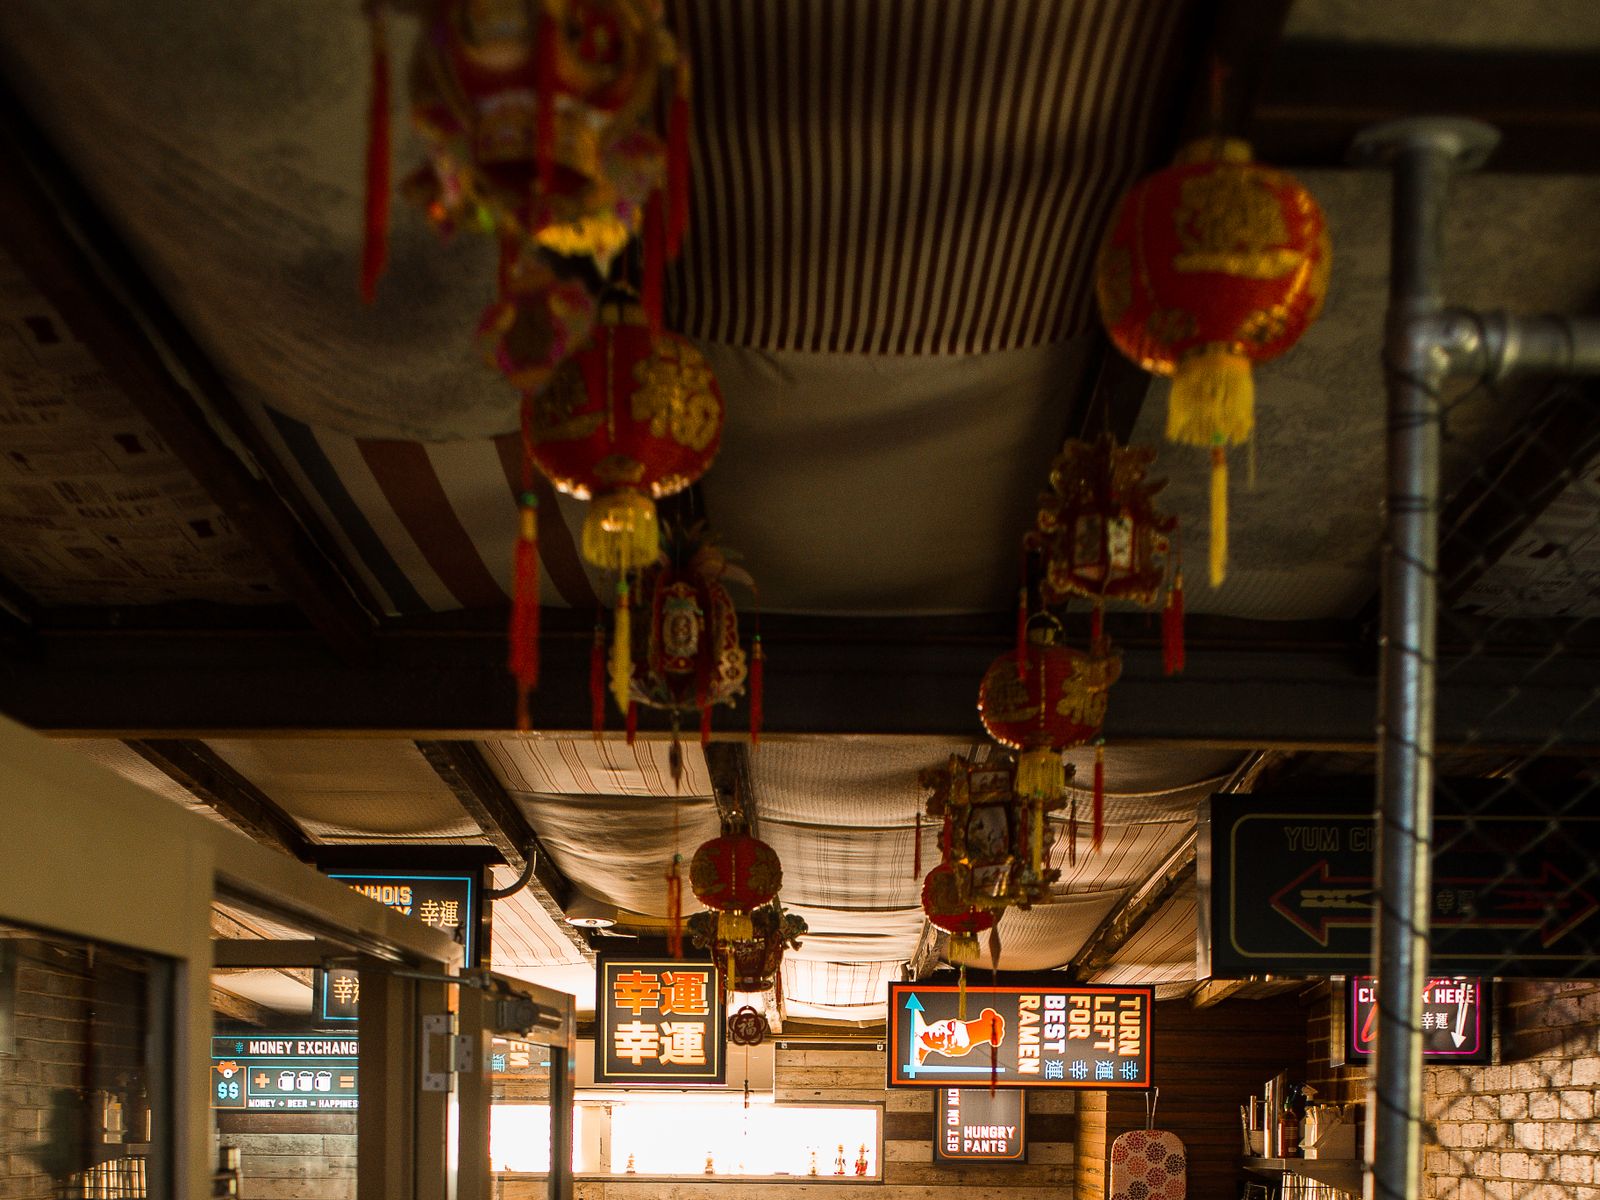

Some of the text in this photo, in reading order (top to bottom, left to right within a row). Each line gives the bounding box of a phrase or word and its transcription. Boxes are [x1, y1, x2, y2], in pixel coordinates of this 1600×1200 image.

[1283, 827, 1339, 851] YUM
[420, 900, 459, 928] 幸運
[614, 970, 710, 1016] 幸運
[1435, 989, 1474, 1004] HERE
[1043, 995, 1066, 1054] BEST
[1068, 996, 1091, 1040] FOR
[1094, 996, 1116, 1054] LEFT
[1118, 997, 1141, 1057] TURN
[1421, 1012, 1449, 1030] 幸運
[614, 1020, 708, 1066] 幸運
[1018, 995, 1041, 1075] RAMEN
[249, 1041, 293, 1055] MONEY
[298, 1041, 359, 1055] EXCHANG
[248, 1098, 276, 1108] MONEY
[287, 1098, 308, 1108] BEER
[318, 1098, 359, 1108] HAPPINES
[947, 1109, 960, 1126] ON
[947, 1129, 960, 1152] GET
[963, 1125, 1017, 1140] HUNGRY
[963, 1139, 1008, 1153] PANTS
